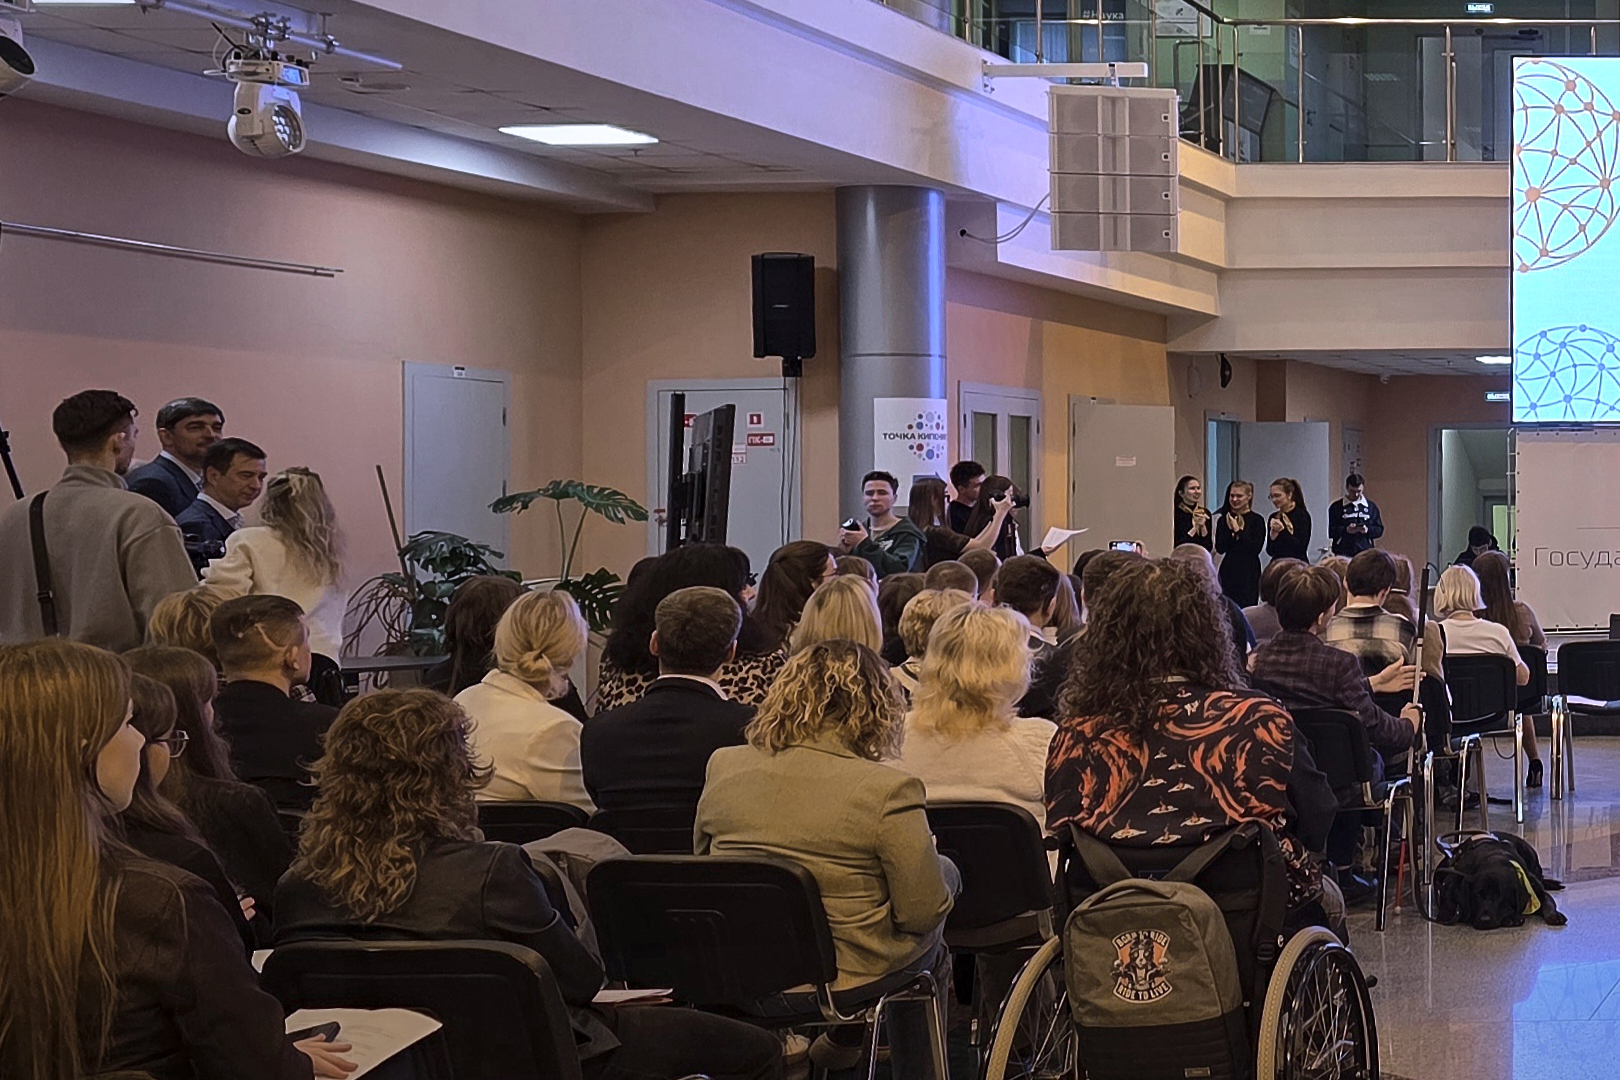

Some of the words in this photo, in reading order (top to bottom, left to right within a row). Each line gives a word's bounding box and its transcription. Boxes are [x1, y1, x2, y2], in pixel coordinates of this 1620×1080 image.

[1150, 931, 1168, 946] RIDE
[1117, 984, 1137, 999] RIDE
[1138, 991, 1149, 1000] TO
[1149, 982, 1169, 998] LIVE
